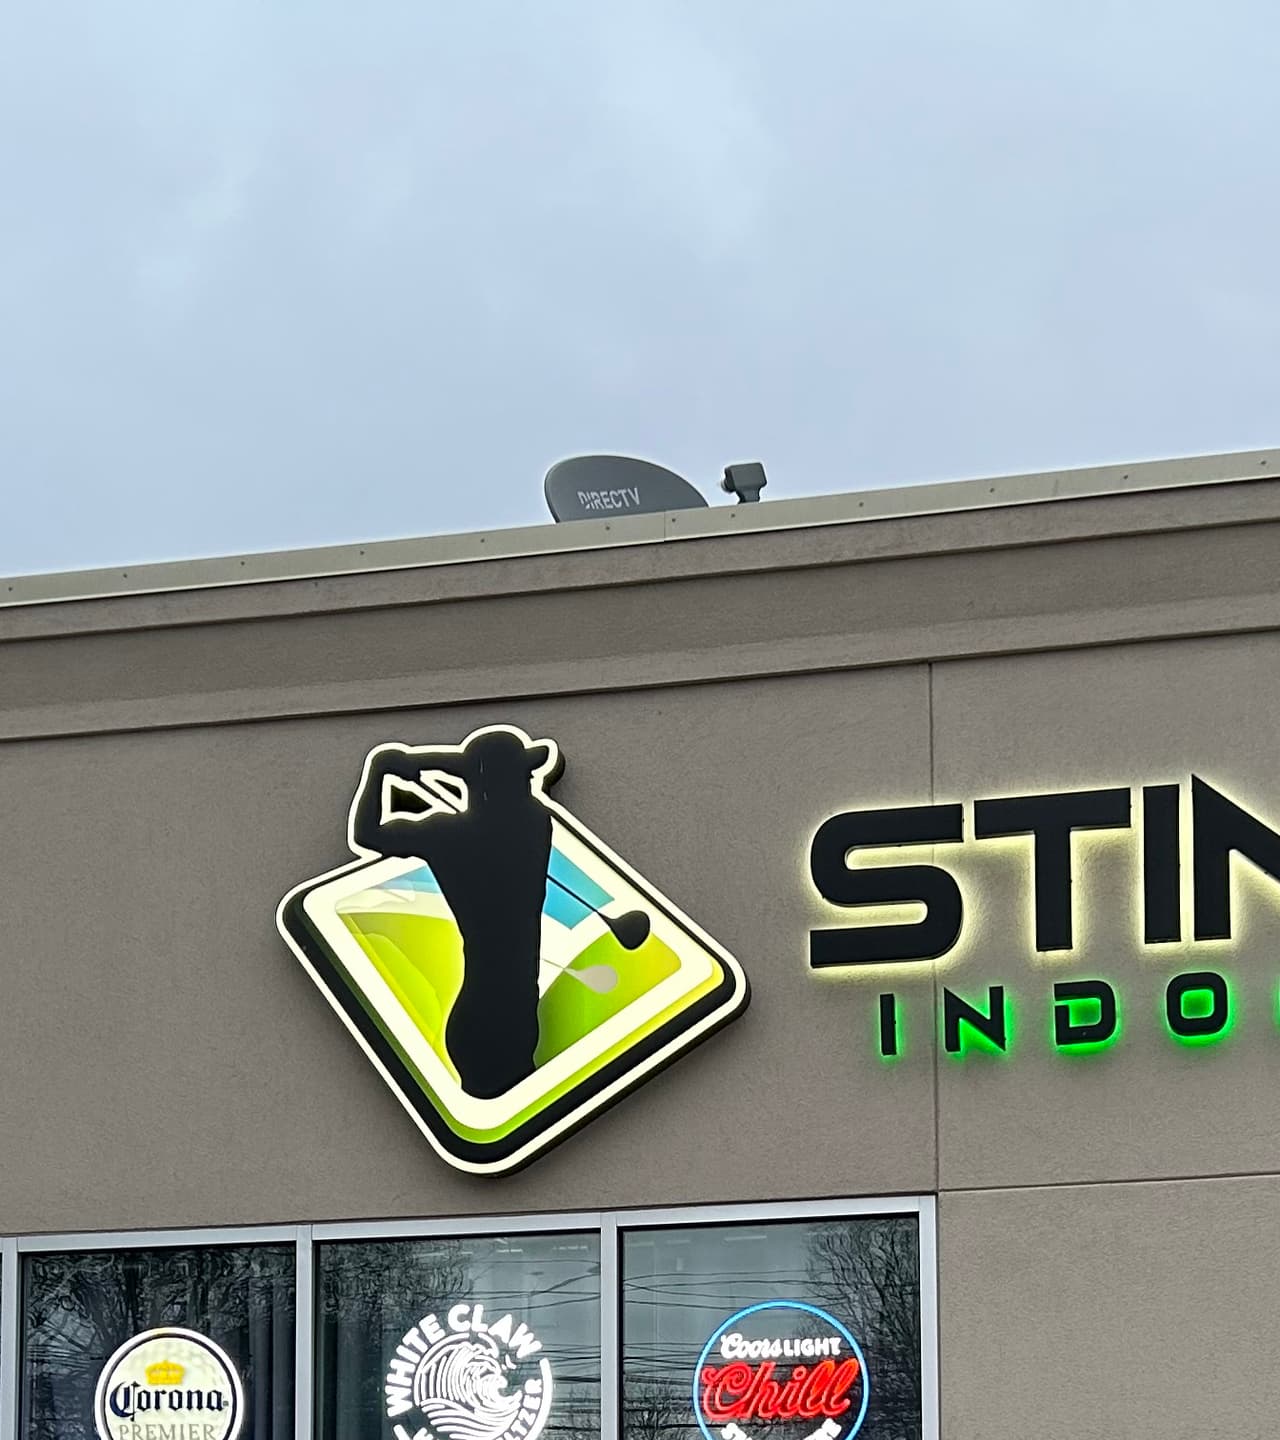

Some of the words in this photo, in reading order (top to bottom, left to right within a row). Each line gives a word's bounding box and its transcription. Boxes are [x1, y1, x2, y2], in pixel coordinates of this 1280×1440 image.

[577, 487, 640, 510] DIRECTV
[384, 1313, 446, 1418] WHITE
[447, 1304, 543, 1359] CLAW
[720, 1333, 782, 1359] Coors
[784, 1336, 842, 1357] LIGHT
[109, 1380, 224, 1423] Corona
[702, 1357, 860, 1421] Chill
